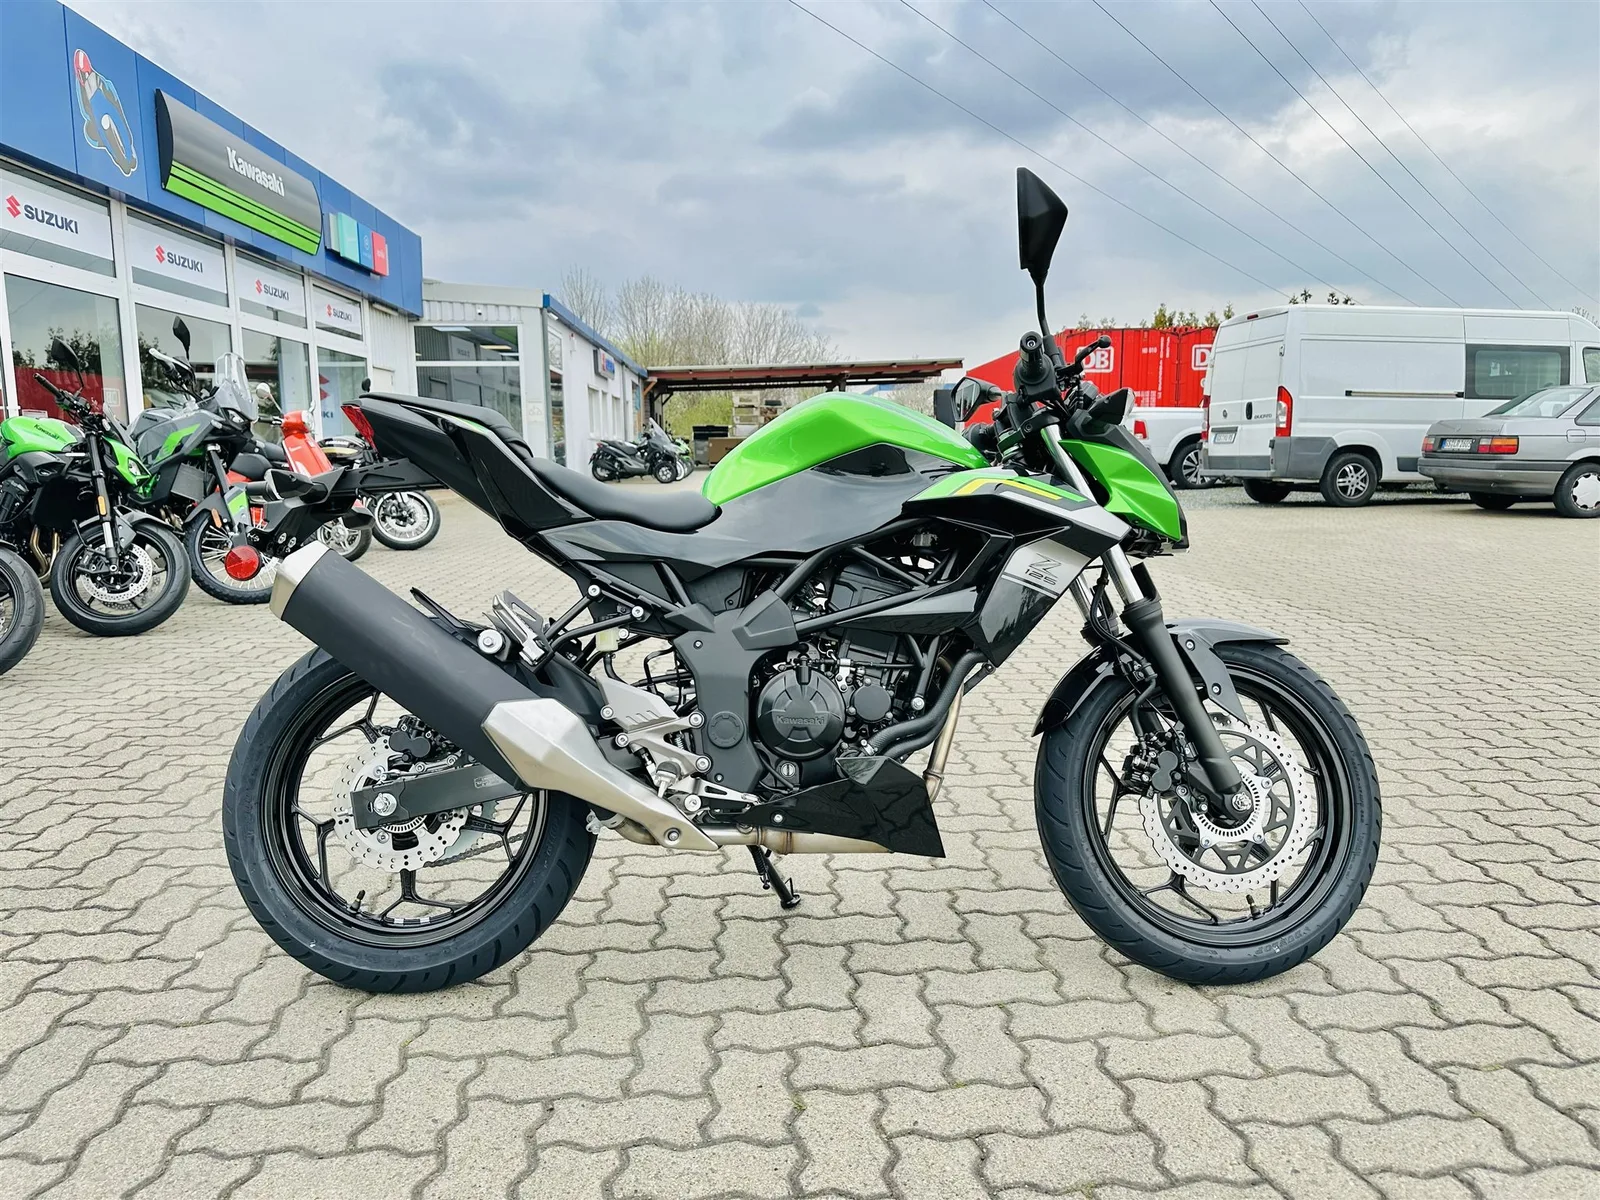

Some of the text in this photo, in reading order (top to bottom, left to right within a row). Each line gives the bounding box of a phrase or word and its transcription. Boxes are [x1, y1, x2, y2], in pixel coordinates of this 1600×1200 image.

[226, 146, 285, 197] Kawasaki
[23, 204, 79, 234] SUZUKI
[167, 252, 204, 273] SUZUKI
[263, 284, 290, 301] SUZUKI
[332, 308, 353, 322] SUZUKI
[1079, 349, 1110, 369] DB
[1029, 552, 1062, 579] Z
[1025, 568, 1057, 586] 125
[776, 714, 825, 726] Kawasaki
